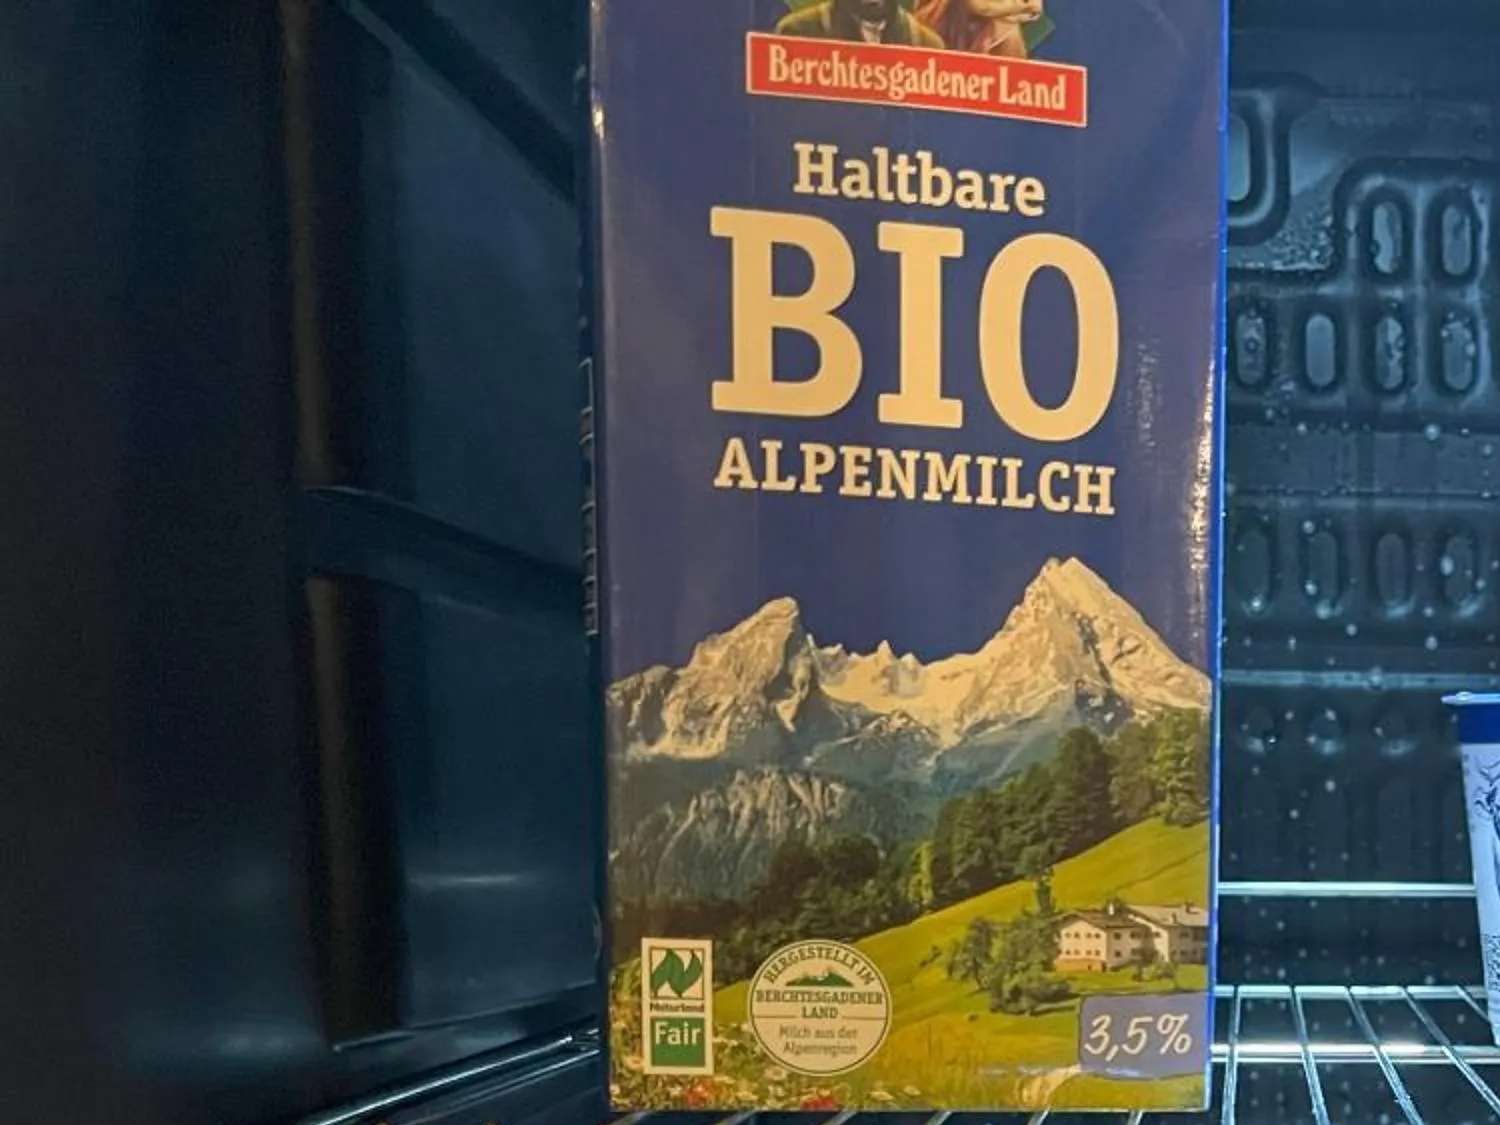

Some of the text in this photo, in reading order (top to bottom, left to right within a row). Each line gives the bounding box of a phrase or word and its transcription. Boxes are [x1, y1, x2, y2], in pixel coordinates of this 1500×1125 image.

[768, 44, 1067, 111] Berchtesgadener Land
[793, 141, 1046, 217] Haltbare
[710, 206, 1120, 442] BIO
[714, 436, 1116, 516] ALPENMILCH
[763, 945, 876, 985] HERGESTELLT IM
[756, 989, 883, 1004] BERCHTESGADENER
[801, 1006, 839, 1019] LAND
[655, 1021, 702, 1045] Fair
[1085, 1013, 1193, 1062] 3,5%
